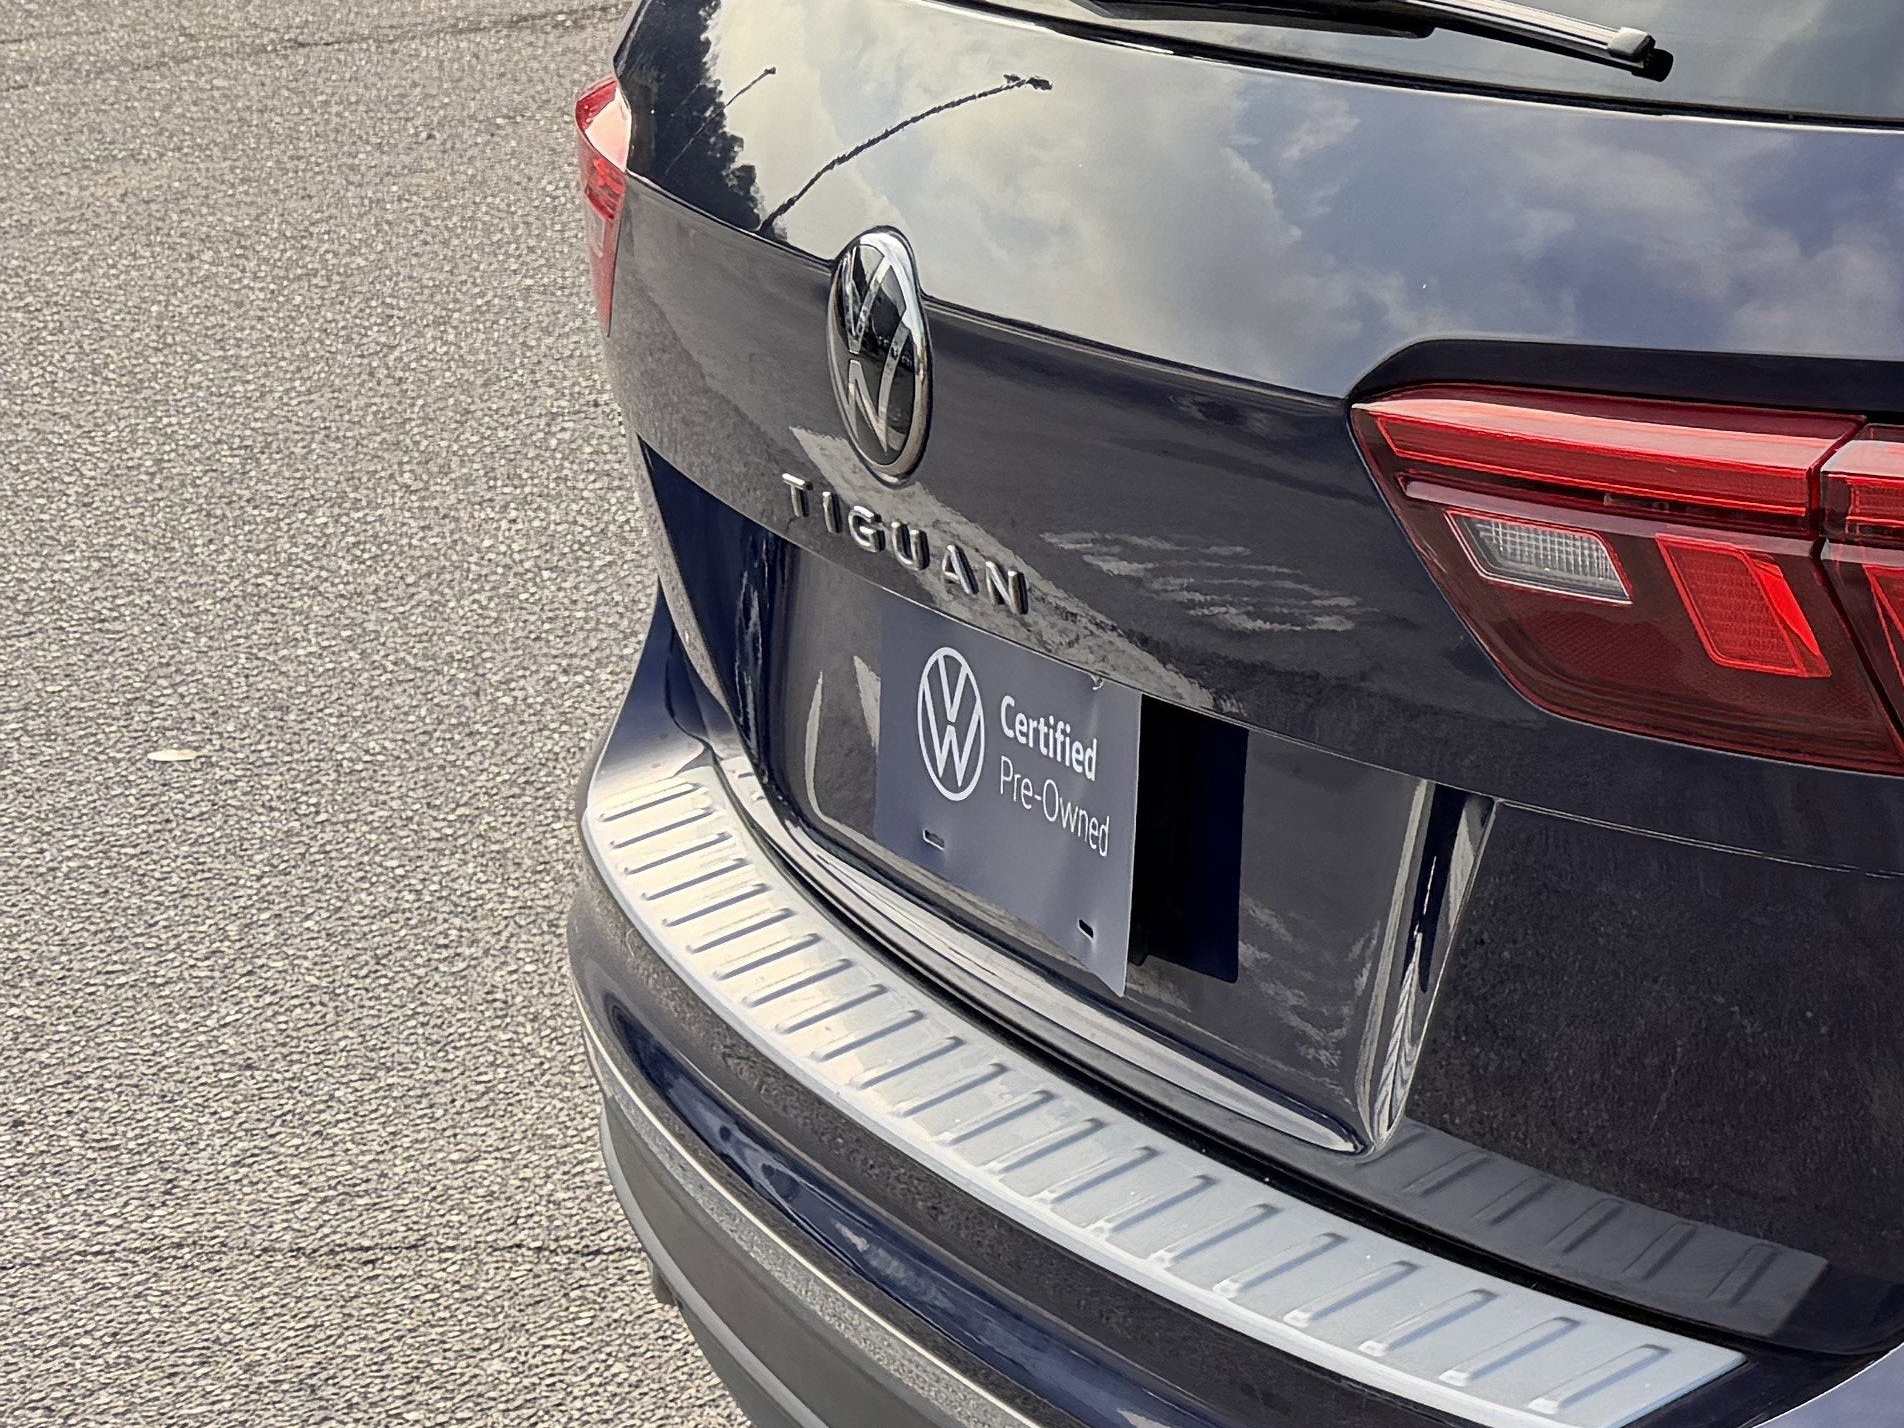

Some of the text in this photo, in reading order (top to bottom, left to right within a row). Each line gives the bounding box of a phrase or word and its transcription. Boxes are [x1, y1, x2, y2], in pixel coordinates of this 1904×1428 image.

[782, 472, 1030, 616] TIGUAN
[1000, 695, 1097, 782] Certified
[1000, 755, 1110, 858] Pre-Owned
